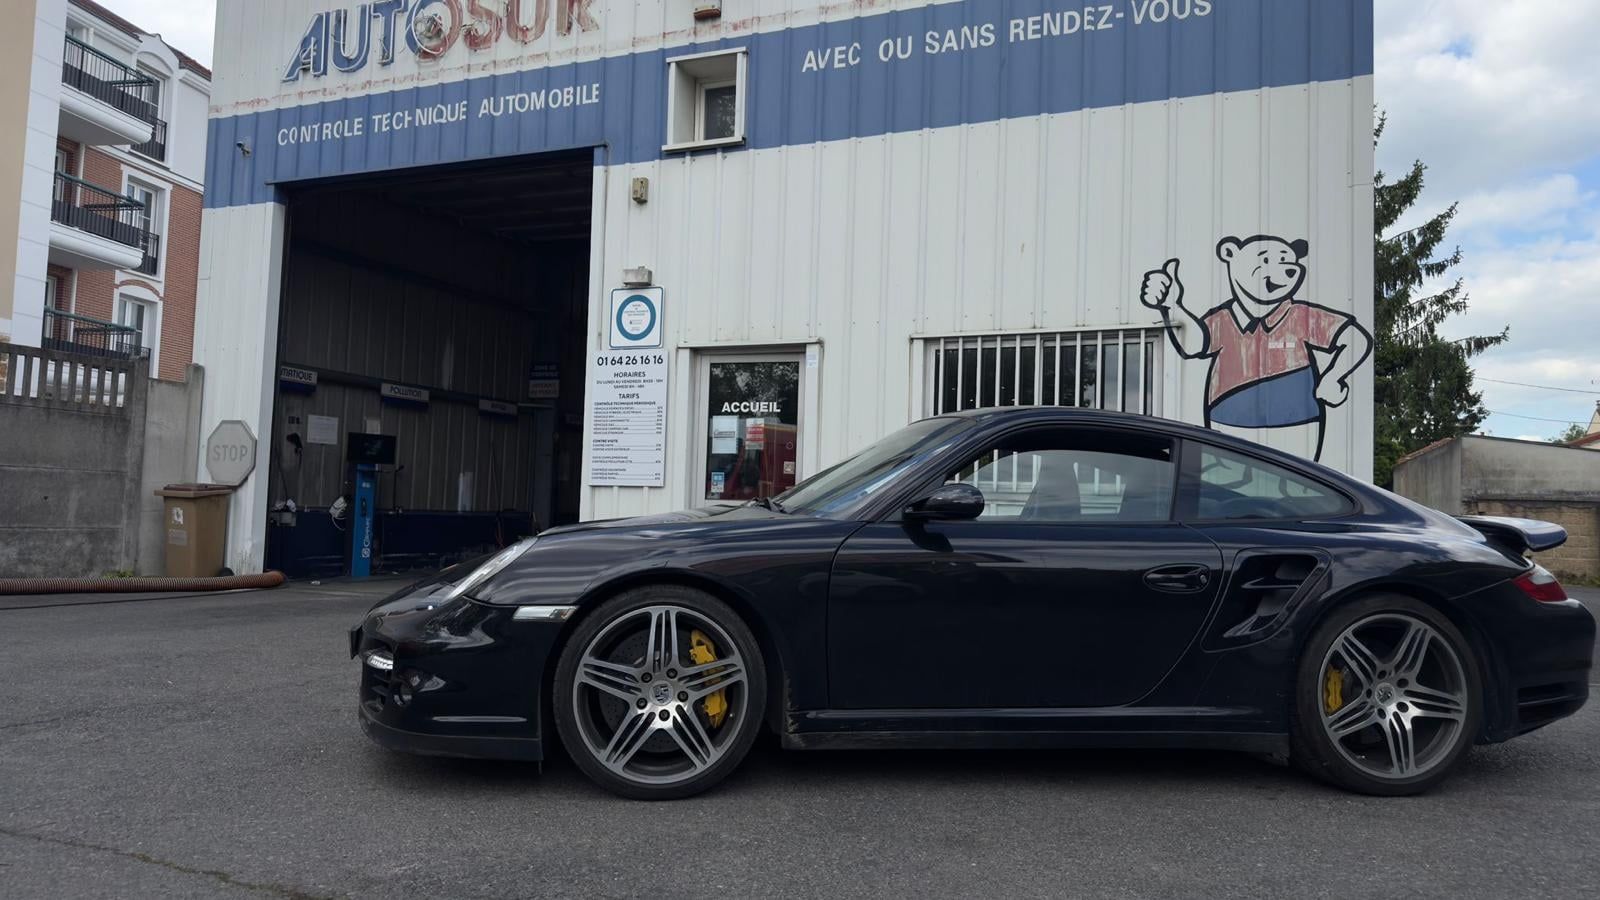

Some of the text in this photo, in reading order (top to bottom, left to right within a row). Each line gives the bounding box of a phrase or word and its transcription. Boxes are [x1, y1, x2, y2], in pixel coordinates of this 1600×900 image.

[802, 42, 861, 73] AVEC
[878, 36, 913, 62] OU
[925, 23, 996, 55] SANS
[277, 83, 600, 147] CONTROLE TECHNIQUE AUTOMOBILE
[597, 355, 663, 366] 01 64 26 16 16
[721, 401, 781, 413] ACCUEIL
[213, 444, 248, 462] STOP
